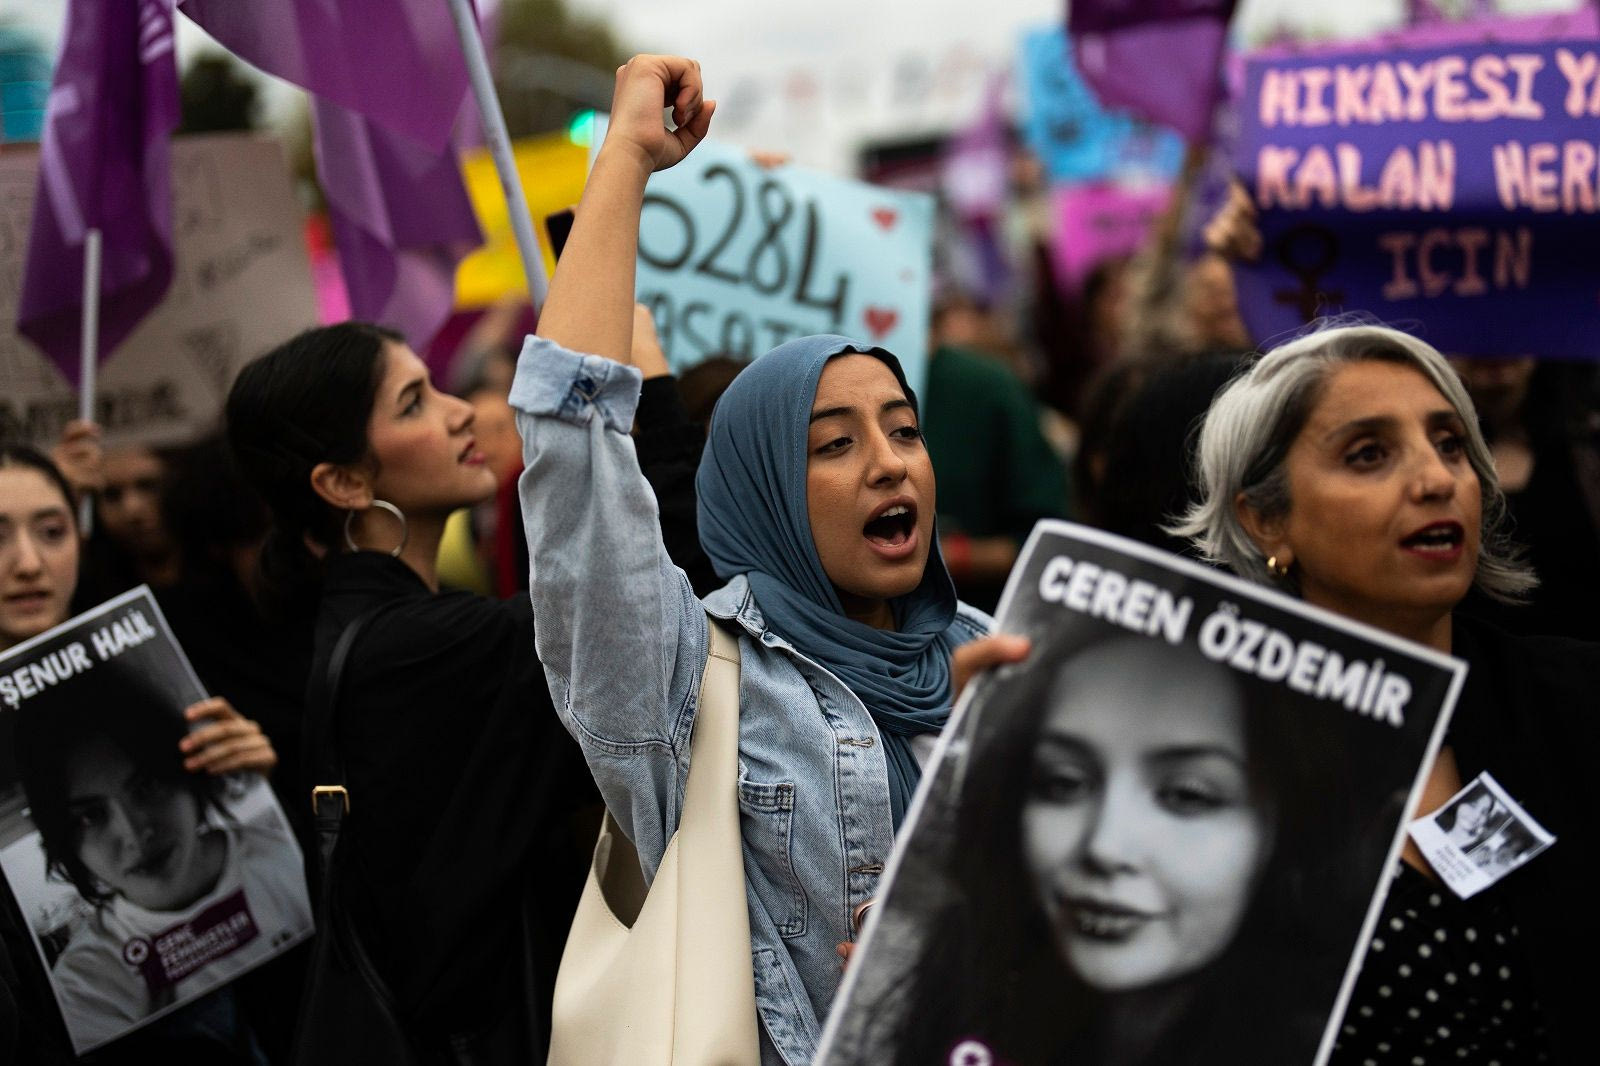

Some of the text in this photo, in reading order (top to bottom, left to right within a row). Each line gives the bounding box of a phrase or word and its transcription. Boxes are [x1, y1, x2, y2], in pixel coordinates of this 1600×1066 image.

[1256, 139, 1600, 215] KALAN HER
[1038, 555, 1413, 729] CEREN ÖZDEMİR
